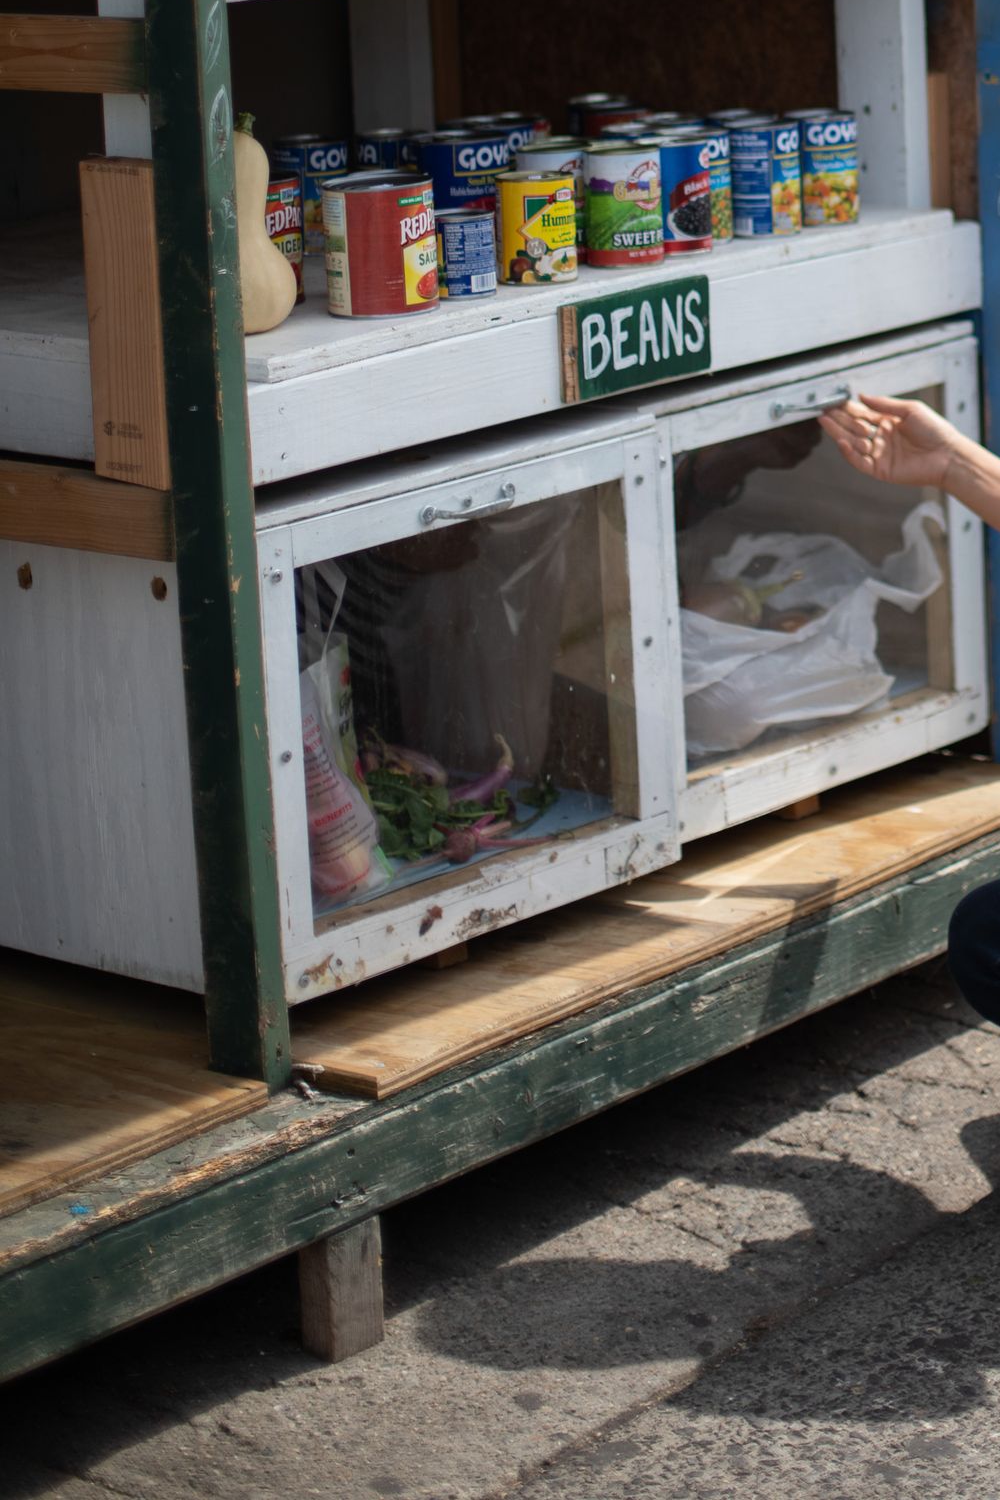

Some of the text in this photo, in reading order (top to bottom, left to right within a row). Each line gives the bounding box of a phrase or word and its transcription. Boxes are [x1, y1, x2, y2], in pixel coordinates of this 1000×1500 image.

[777, 129, 799, 153] GO
[613, 230, 655, 247] SWEET
[582, 290, 704, 381] BEANS
